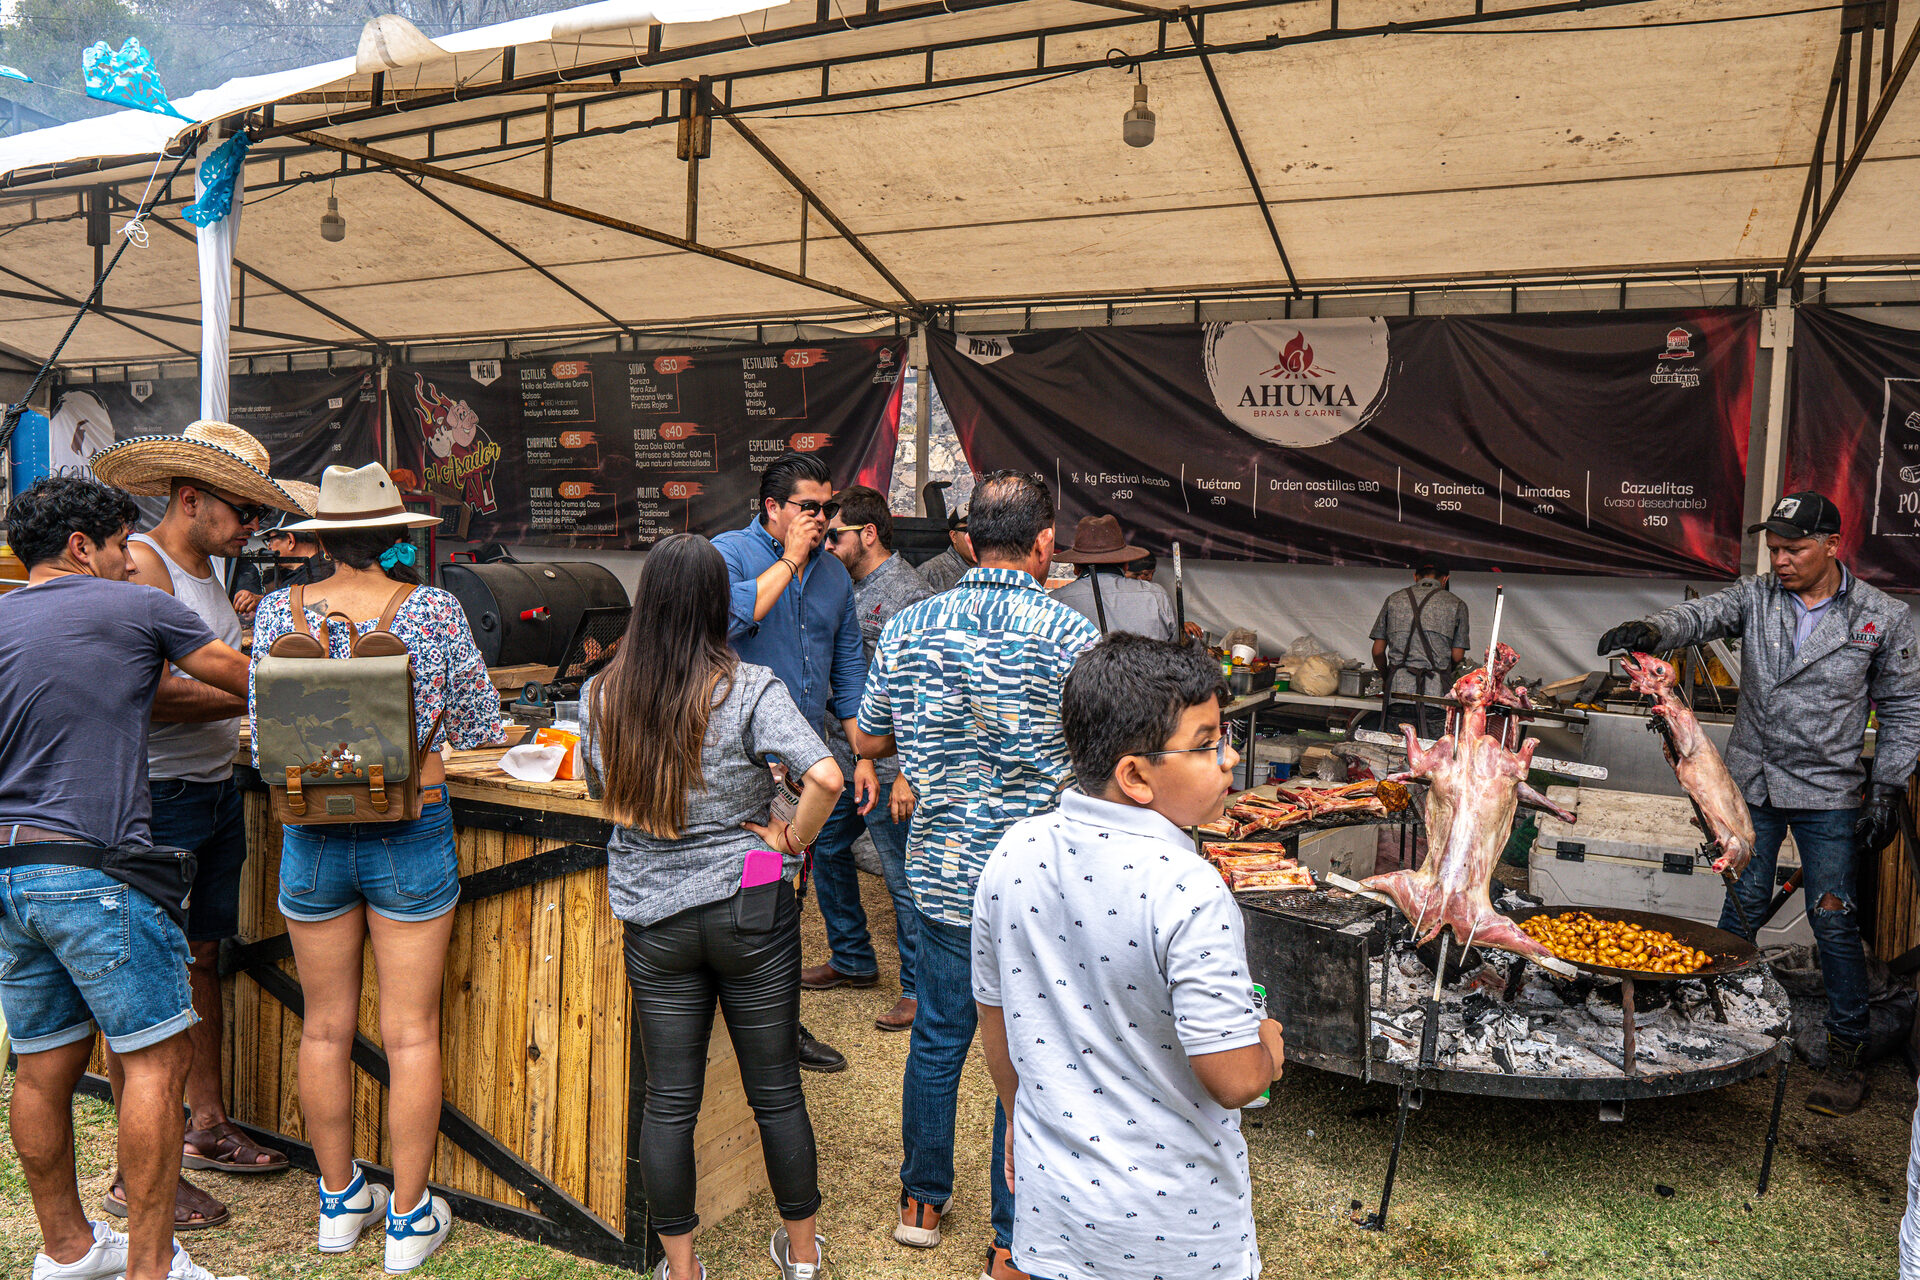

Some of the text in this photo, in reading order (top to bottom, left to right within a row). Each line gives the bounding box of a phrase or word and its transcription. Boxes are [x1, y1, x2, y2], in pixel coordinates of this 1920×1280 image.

[968, 338, 1002, 356] MENÚ
[742, 356, 778, 370] DESTILADOS
[790, 352, 808, 366] $75
[556, 364, 578, 376] $395
[660, 359, 677, 372] $50
[520, 368, 546, 380] COSTILLAS
[744, 372, 756, 380] Ron
[1650, 372, 1698, 384] QUERÉTARO
[744, 380, 767, 390] Tequila
[1237, 384, 1358, 408] AHUMA
[652, 401, 668, 410] Rojos
[746, 399, 767, 408] Whisky
[747, 408, 767, 416] Torres
[1254, 410, 1289, 418] BRASA
[665, 425, 682, 438] $40
[566, 434, 581, 446] $85
[749, 440, 785, 452] ESPECIALES
[796, 436, 815, 449] $95
[440, 440, 501, 488] Asador
[636, 460, 650, 469] Agua
[1085, 472, 1097, 486] kg
[1100, 472, 1140, 484] Festival
[1142, 476, 1170, 487] Asado
[1196, 478, 1241, 490] Tuétano
[1270, 479, 1302, 491] Orden
[1306, 480, 1356, 492] costillas
[565, 485, 580, 496] $80
[669, 485, 686, 496] $80
[1414, 483, 1485, 496] Kg Tocineta
[1517, 485, 1570, 499] Limadas
[1621, 481, 1694, 495] Cazuelitas
[1112, 490, 1133, 500] $450
[1210, 496, 1226, 505] $50
[638, 502, 658, 510] Pepino
[1314, 498, 1338, 508] $200
[1436, 501, 1462, 511] $550
[1604, 496, 1707, 509] (vaso desechable)
[1897, 491, 1920, 514] PO
[1533, 504, 1554, 515] $110
[1643, 516, 1668, 527] $150
[659, 526, 674, 535] Rojos
